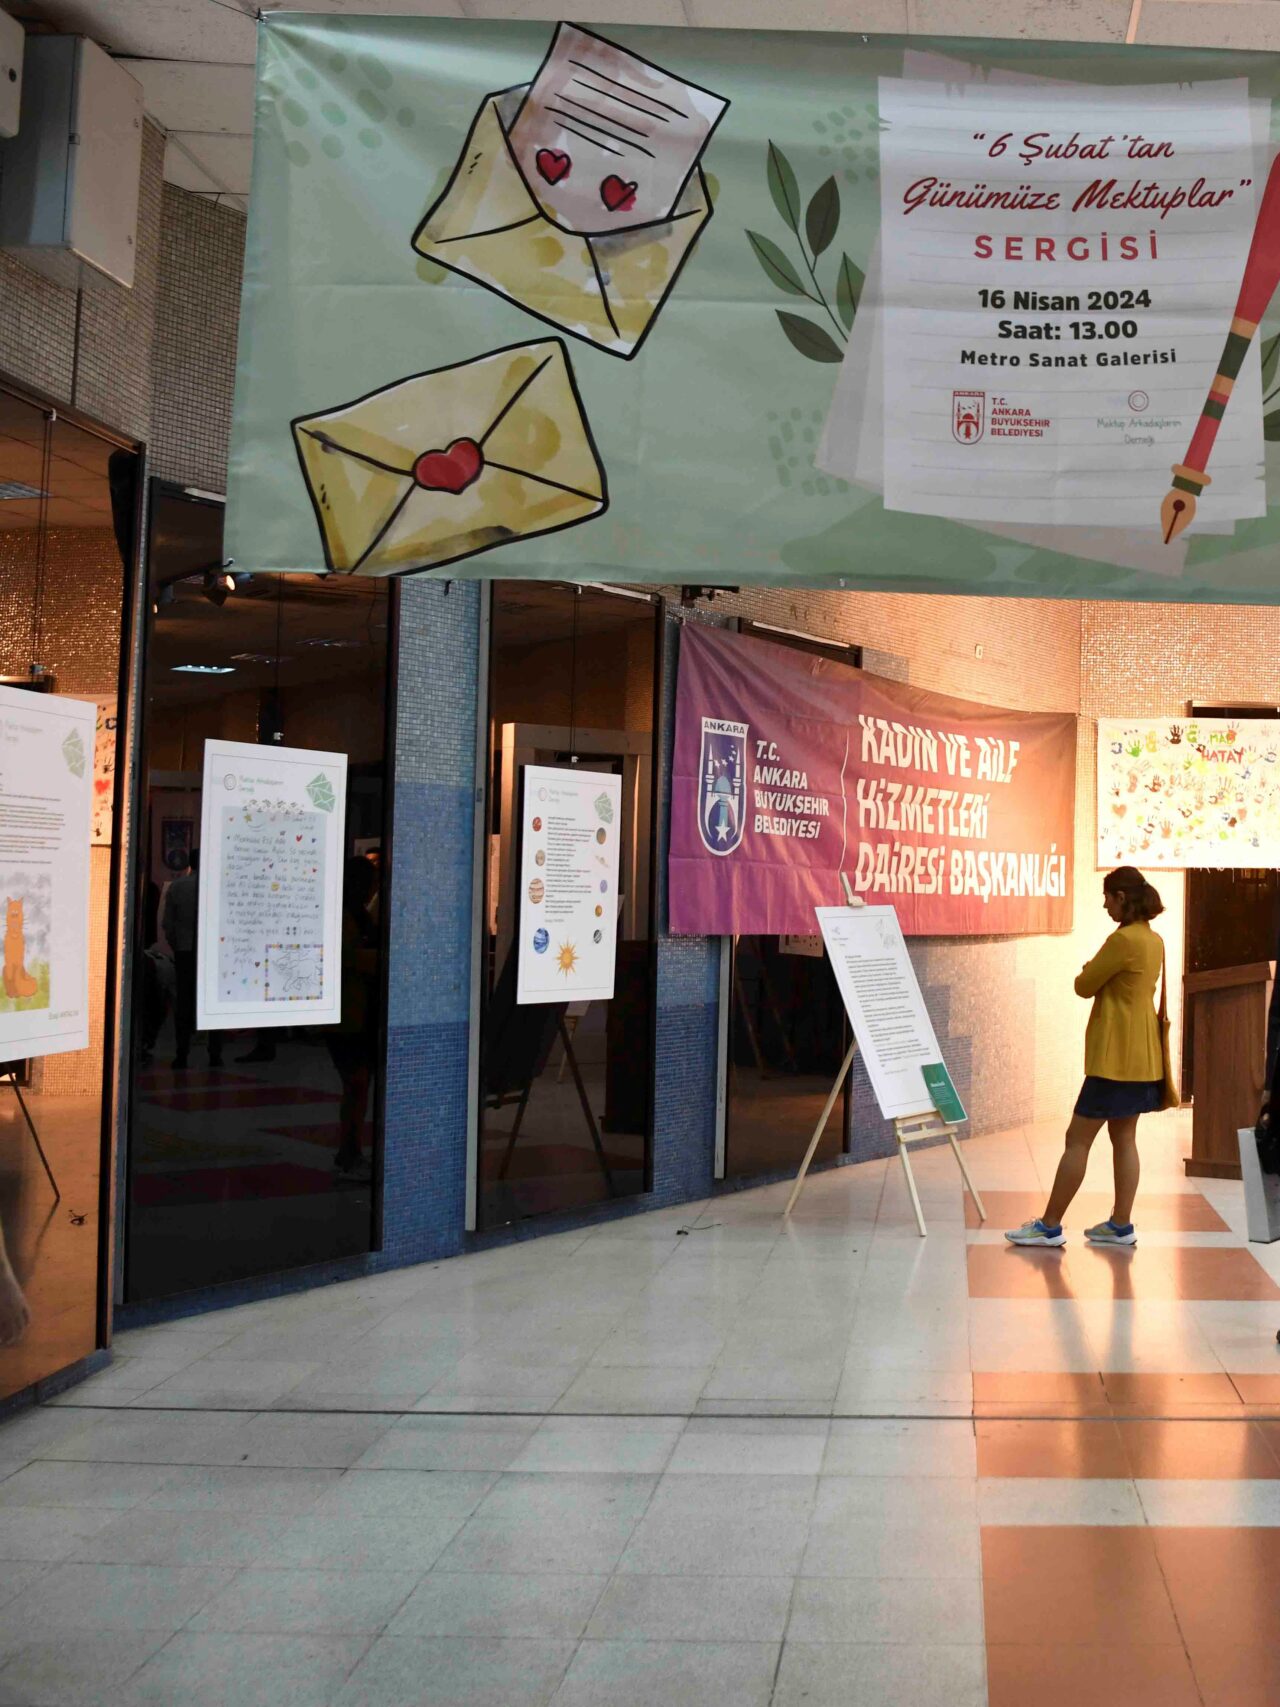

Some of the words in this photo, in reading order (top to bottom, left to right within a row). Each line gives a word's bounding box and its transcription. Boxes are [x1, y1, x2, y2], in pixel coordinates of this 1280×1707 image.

[902, 176, 1061, 215] Günümüze
[1071, 177, 1252, 220] Mektuplar”
[973, 229, 1158, 262] SERGİSİ
[978, 288, 1006, 309] 16
[1013, 291, 1080, 311] Nisan
[1087, 289, 1152, 310] 2024
[998, 320, 1061, 340] Saat:
[1069, 320, 1138, 340] 13.00
[960, 349, 1020, 367] Metro
[1029, 352, 1088, 367] Sanat
[1096, 348, 1176, 367] Galerisi
[991, 397, 1008, 406] T.C.
[991, 407, 1031, 416] ANKARA
[704, 720, 745, 734] ANKARA
[756, 740, 780, 761] T.C.
[858, 714, 939, 773] KADIN
[937, 731, 972, 778] VE
[974, 736, 1020, 783] AİLE
[1201, 746, 1244, 764] HATAY
[753, 765, 808, 789] ANKARA
[856, 778, 991, 839] HİZMETLERİ
[754, 814, 821, 839] BELEDİYESİ
[855, 841, 945, 895] DAİRESİ
[950, 843, 1066, 904] BAŞKANLIĞI
